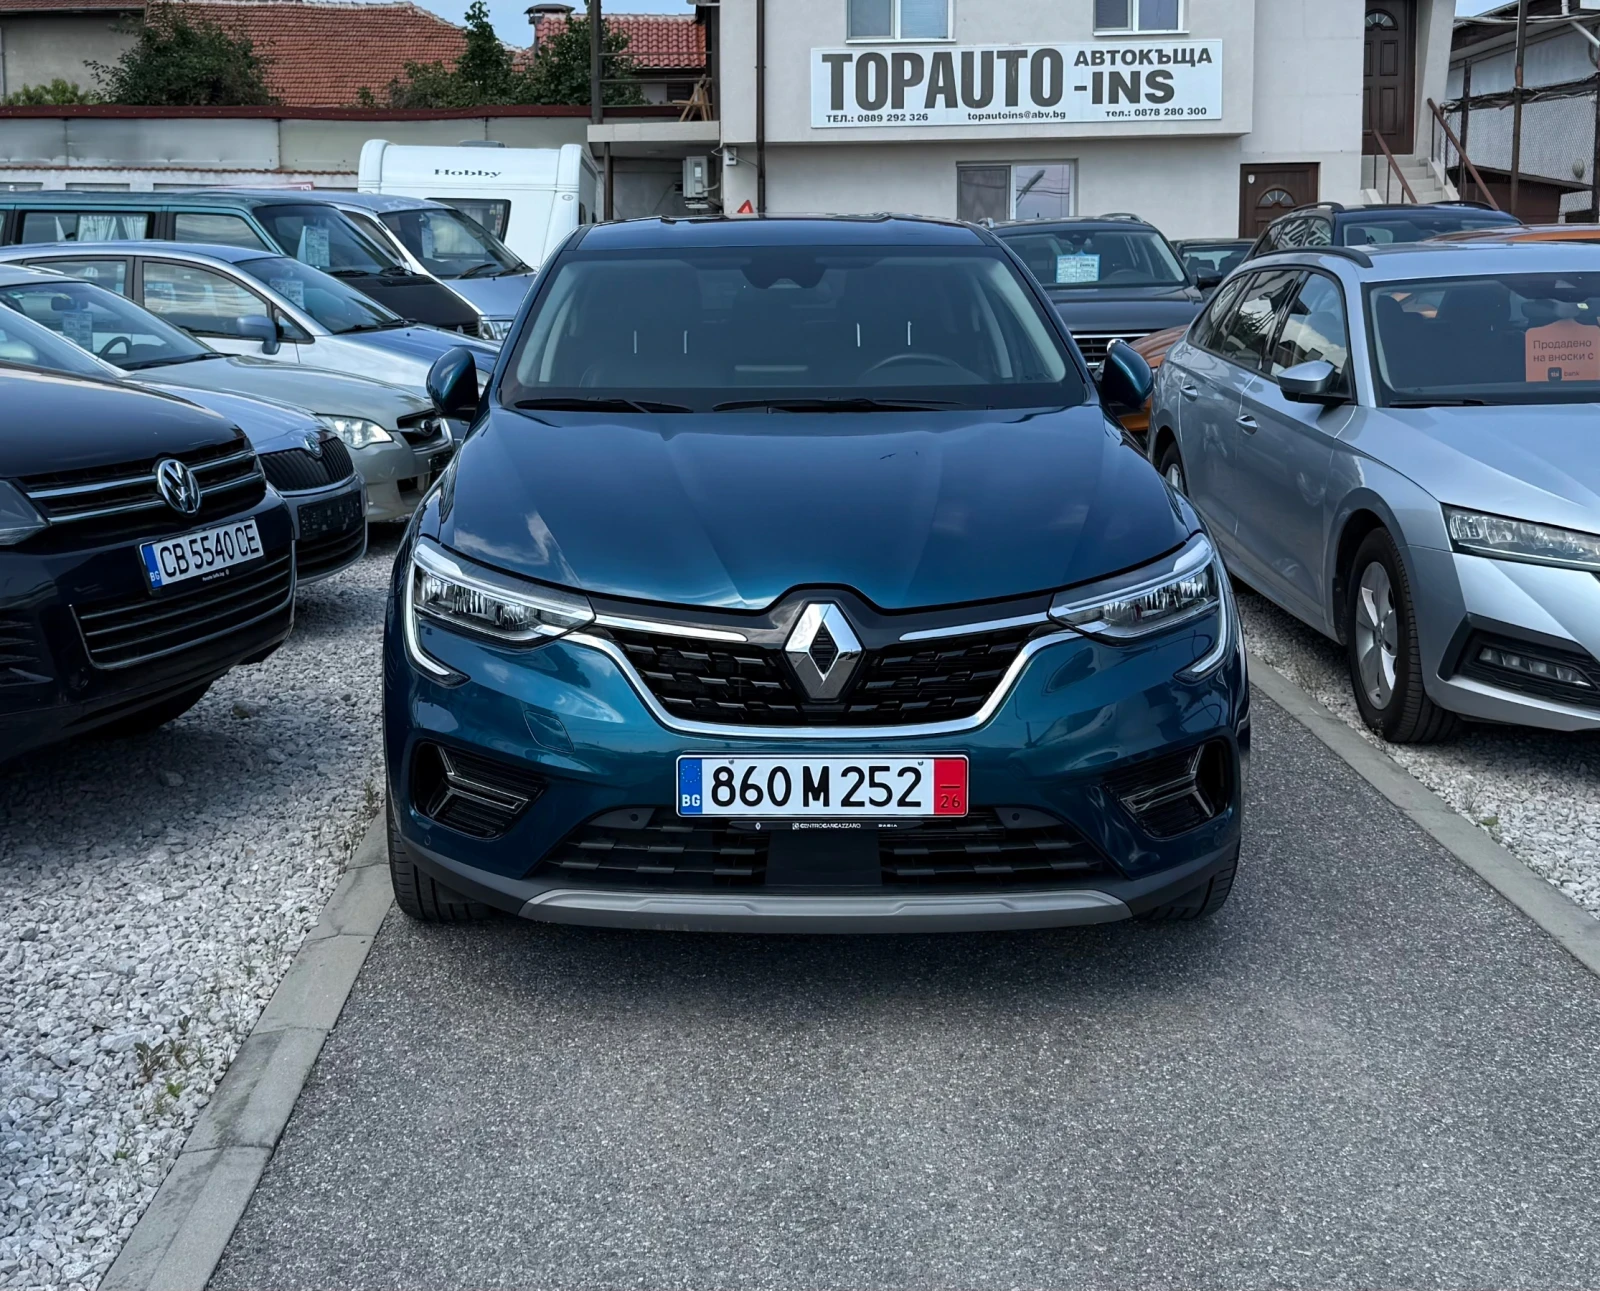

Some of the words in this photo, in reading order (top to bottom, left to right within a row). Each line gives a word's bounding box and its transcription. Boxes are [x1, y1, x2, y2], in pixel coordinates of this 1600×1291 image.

[1074, 47, 1212, 67] АВТОКЪЩА
[821, 48, 1064, 111] TOPAUTO
[1074, 69, 1175, 104] -INS
[967, 110, 1066, 122] topautoins@abv.bg
[1134, 108, 1160, 117] 0878
[1163, 107, 1184, 116] 280
[1187, 106, 1207, 115] 300
[826, 114, 854, 123] ТЕЛ.:
[857, 114, 883, 122] 0889
[886, 113, 906, 122] 292
[909, 113, 929, 121] 326
[434, 168, 502, 178] Hobby
[1533, 340, 1592, 350] Продадено
[1533, 354, 1546, 362] на
[1548, 353, 1586, 362] вноски
[1587, 352, 1594, 360] с
[188, 529, 235, 570] 5540
[149, 570, 160, 582] BG
[711, 765, 792, 807] 860
[802, 765, 830, 808] M
[840, 765, 922, 807] 252
[682, 794, 701, 807] BG
[940, 793, 961, 809] 26
